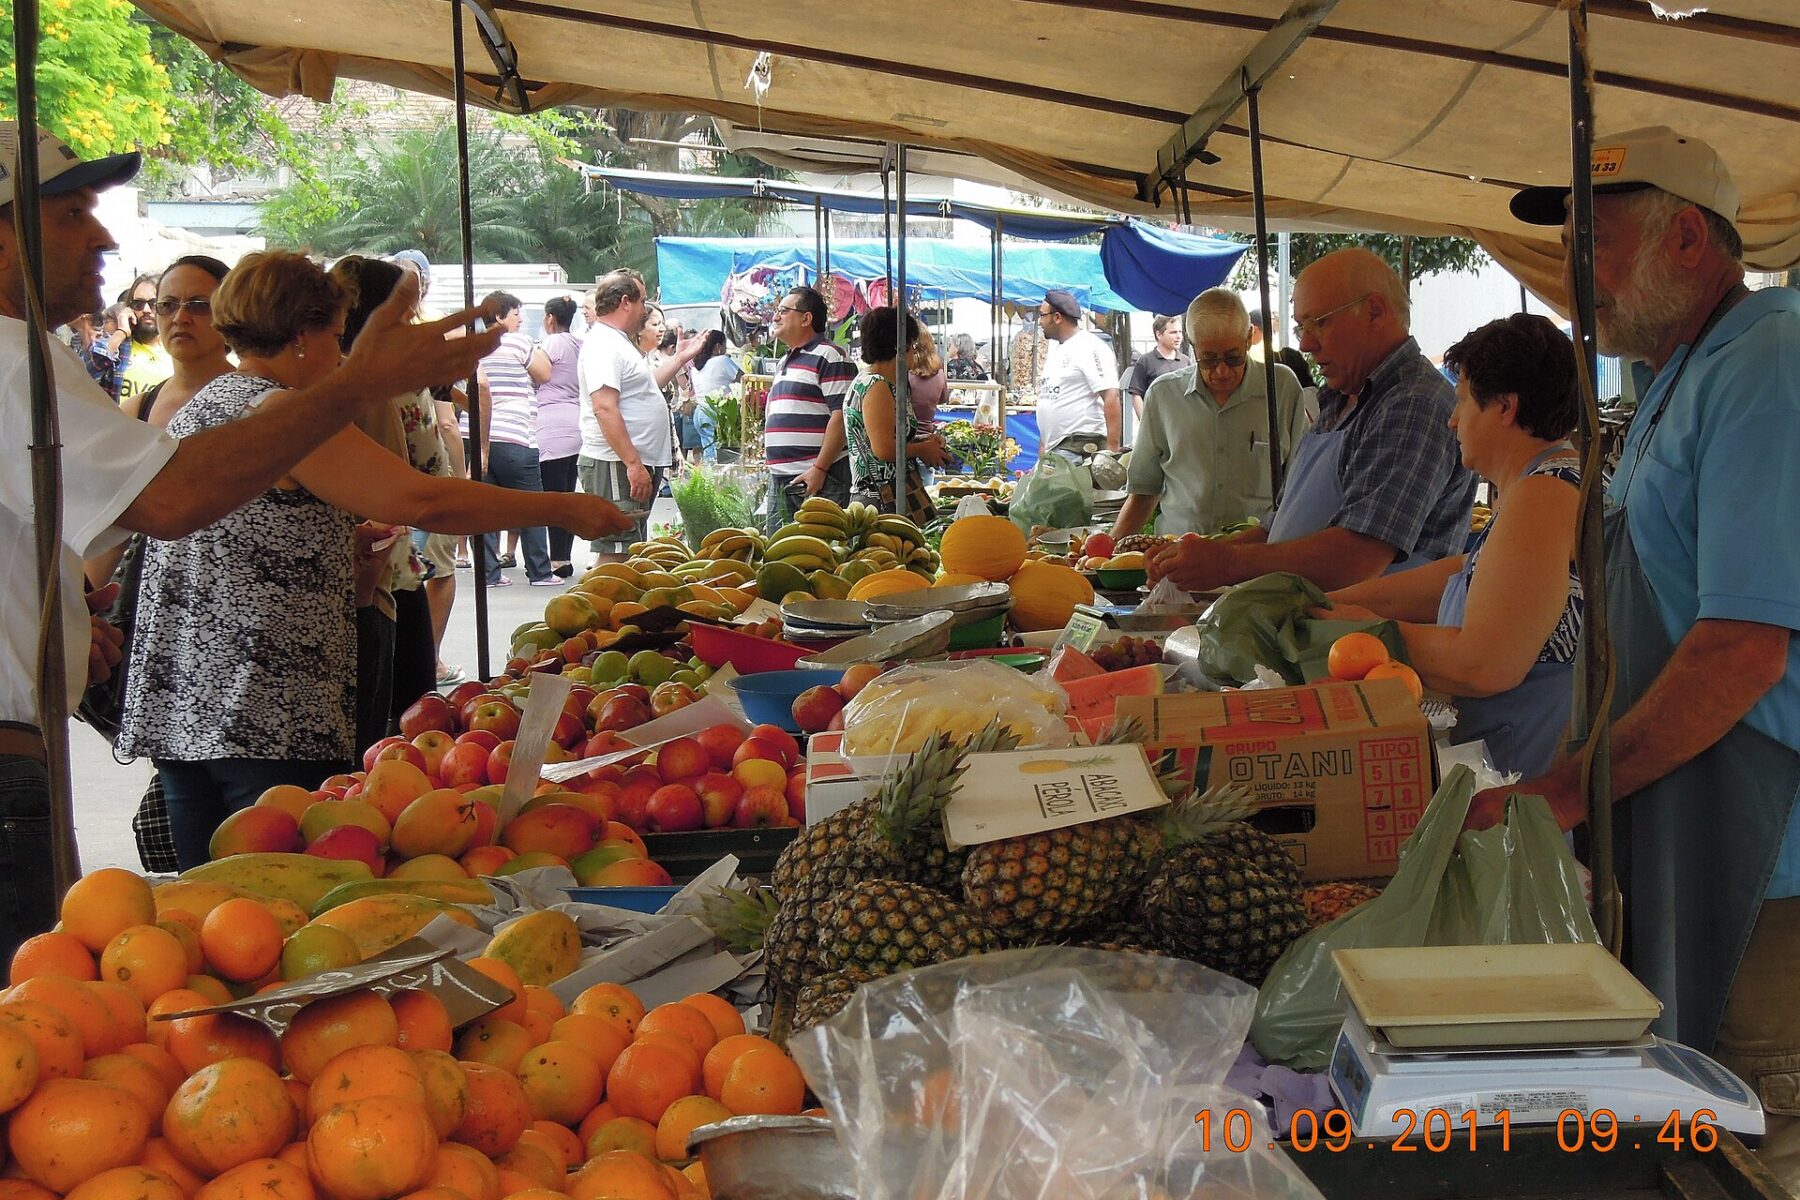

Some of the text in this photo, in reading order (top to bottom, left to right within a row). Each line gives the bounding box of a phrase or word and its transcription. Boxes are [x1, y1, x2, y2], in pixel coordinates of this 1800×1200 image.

[1225, 741, 1277, 755] GRUPO
[1368, 742, 1412, 757] TIPO
[1229, 749, 1352, 782] OTANI
[1372, 762, 1411, 780] 5 6
[1088, 773, 1128, 812] ABACAXI
[1293, 781, 1304, 789] 13
[1041, 781, 1080, 818] PÉROLA
[1374, 788, 1413, 805] 7 8
[1374, 813, 1418, 831] 9 10
[1374, 840, 1393, 856] 11
